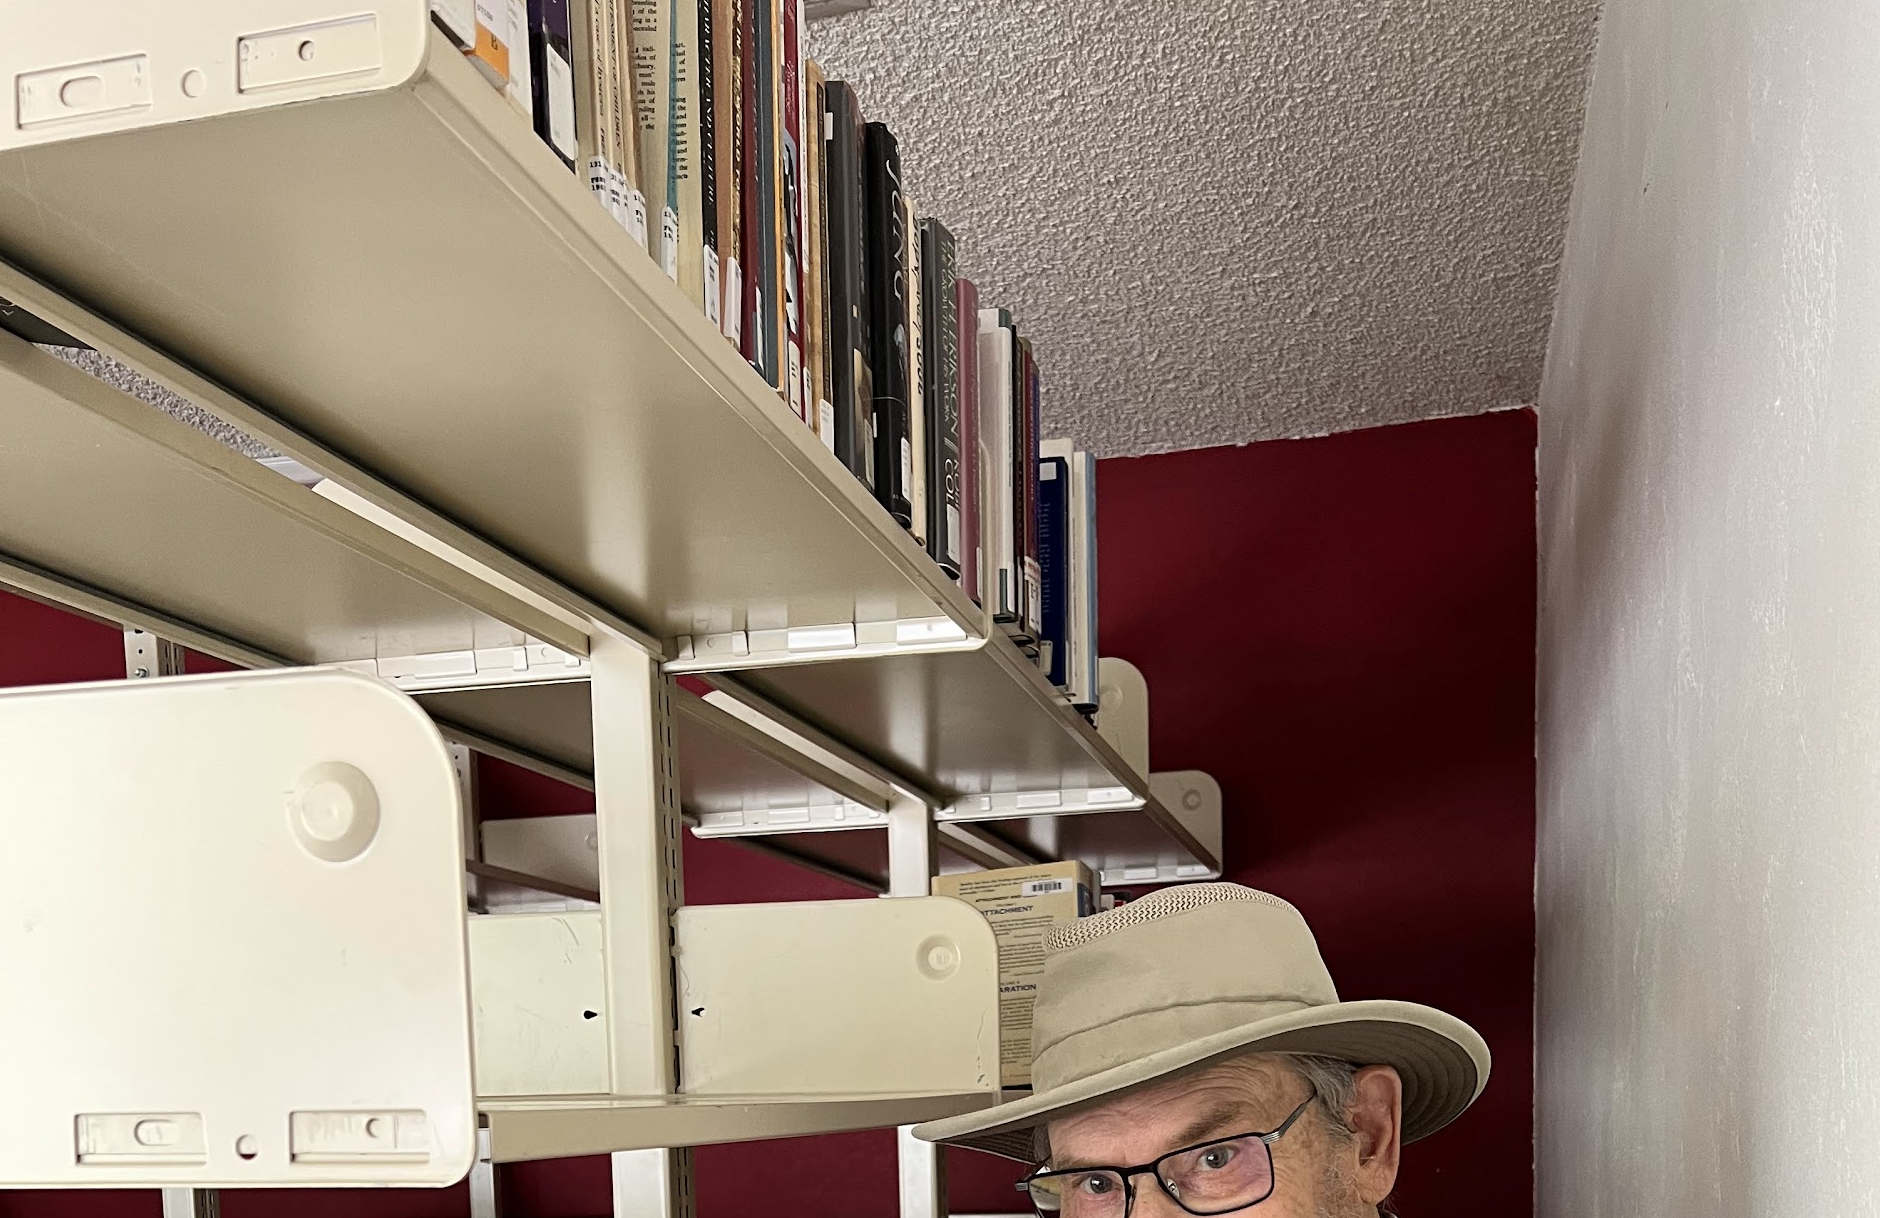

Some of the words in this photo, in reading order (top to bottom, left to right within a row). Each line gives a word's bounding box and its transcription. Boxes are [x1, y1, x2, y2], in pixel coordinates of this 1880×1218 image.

[947, 240, 957, 289] ERIK
[949, 330, 958, 436] ERIKSON
[945, 459, 954, 504] COL
[1000, 984, 1036, 992] ARATION
